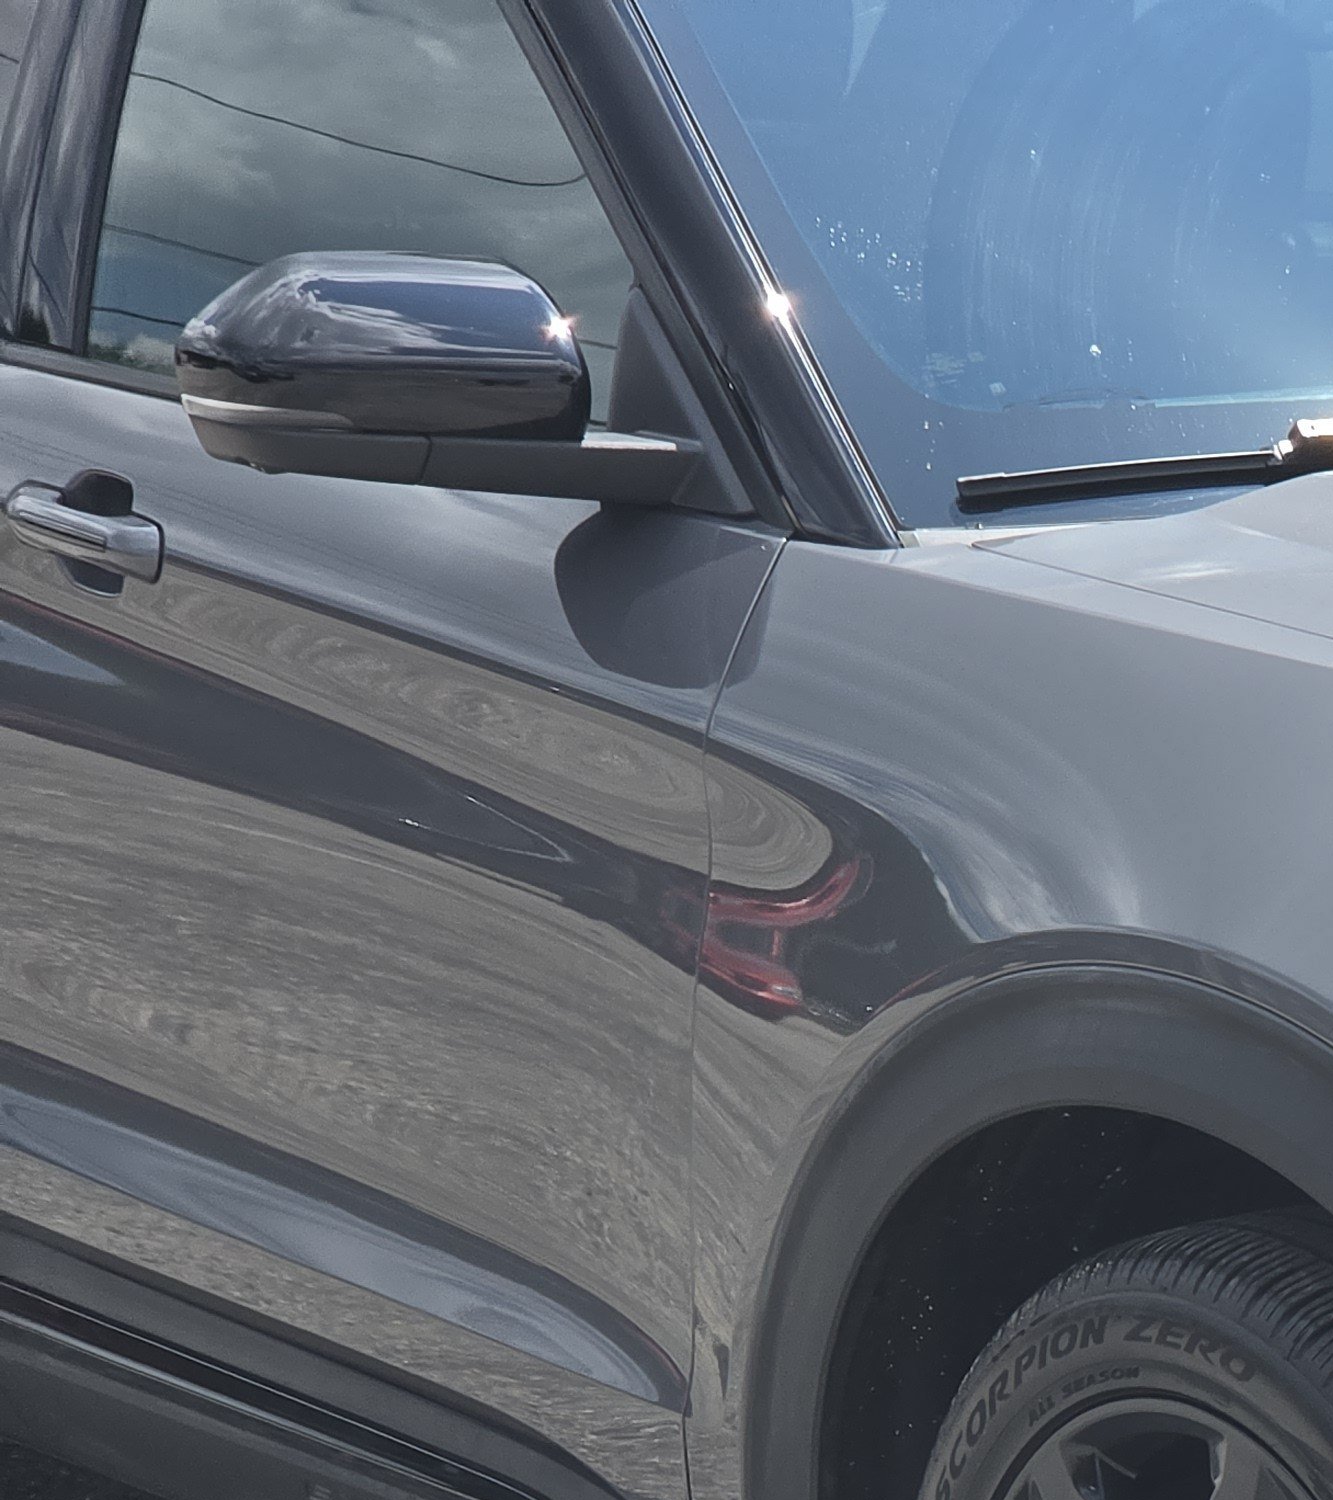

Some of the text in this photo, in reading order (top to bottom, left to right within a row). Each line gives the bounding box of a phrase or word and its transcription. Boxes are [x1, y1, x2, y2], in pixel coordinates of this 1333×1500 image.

[1123, 1316, 1257, 1382] ZERO
[1028, 1366, 1140, 1428] ALL SEASON
